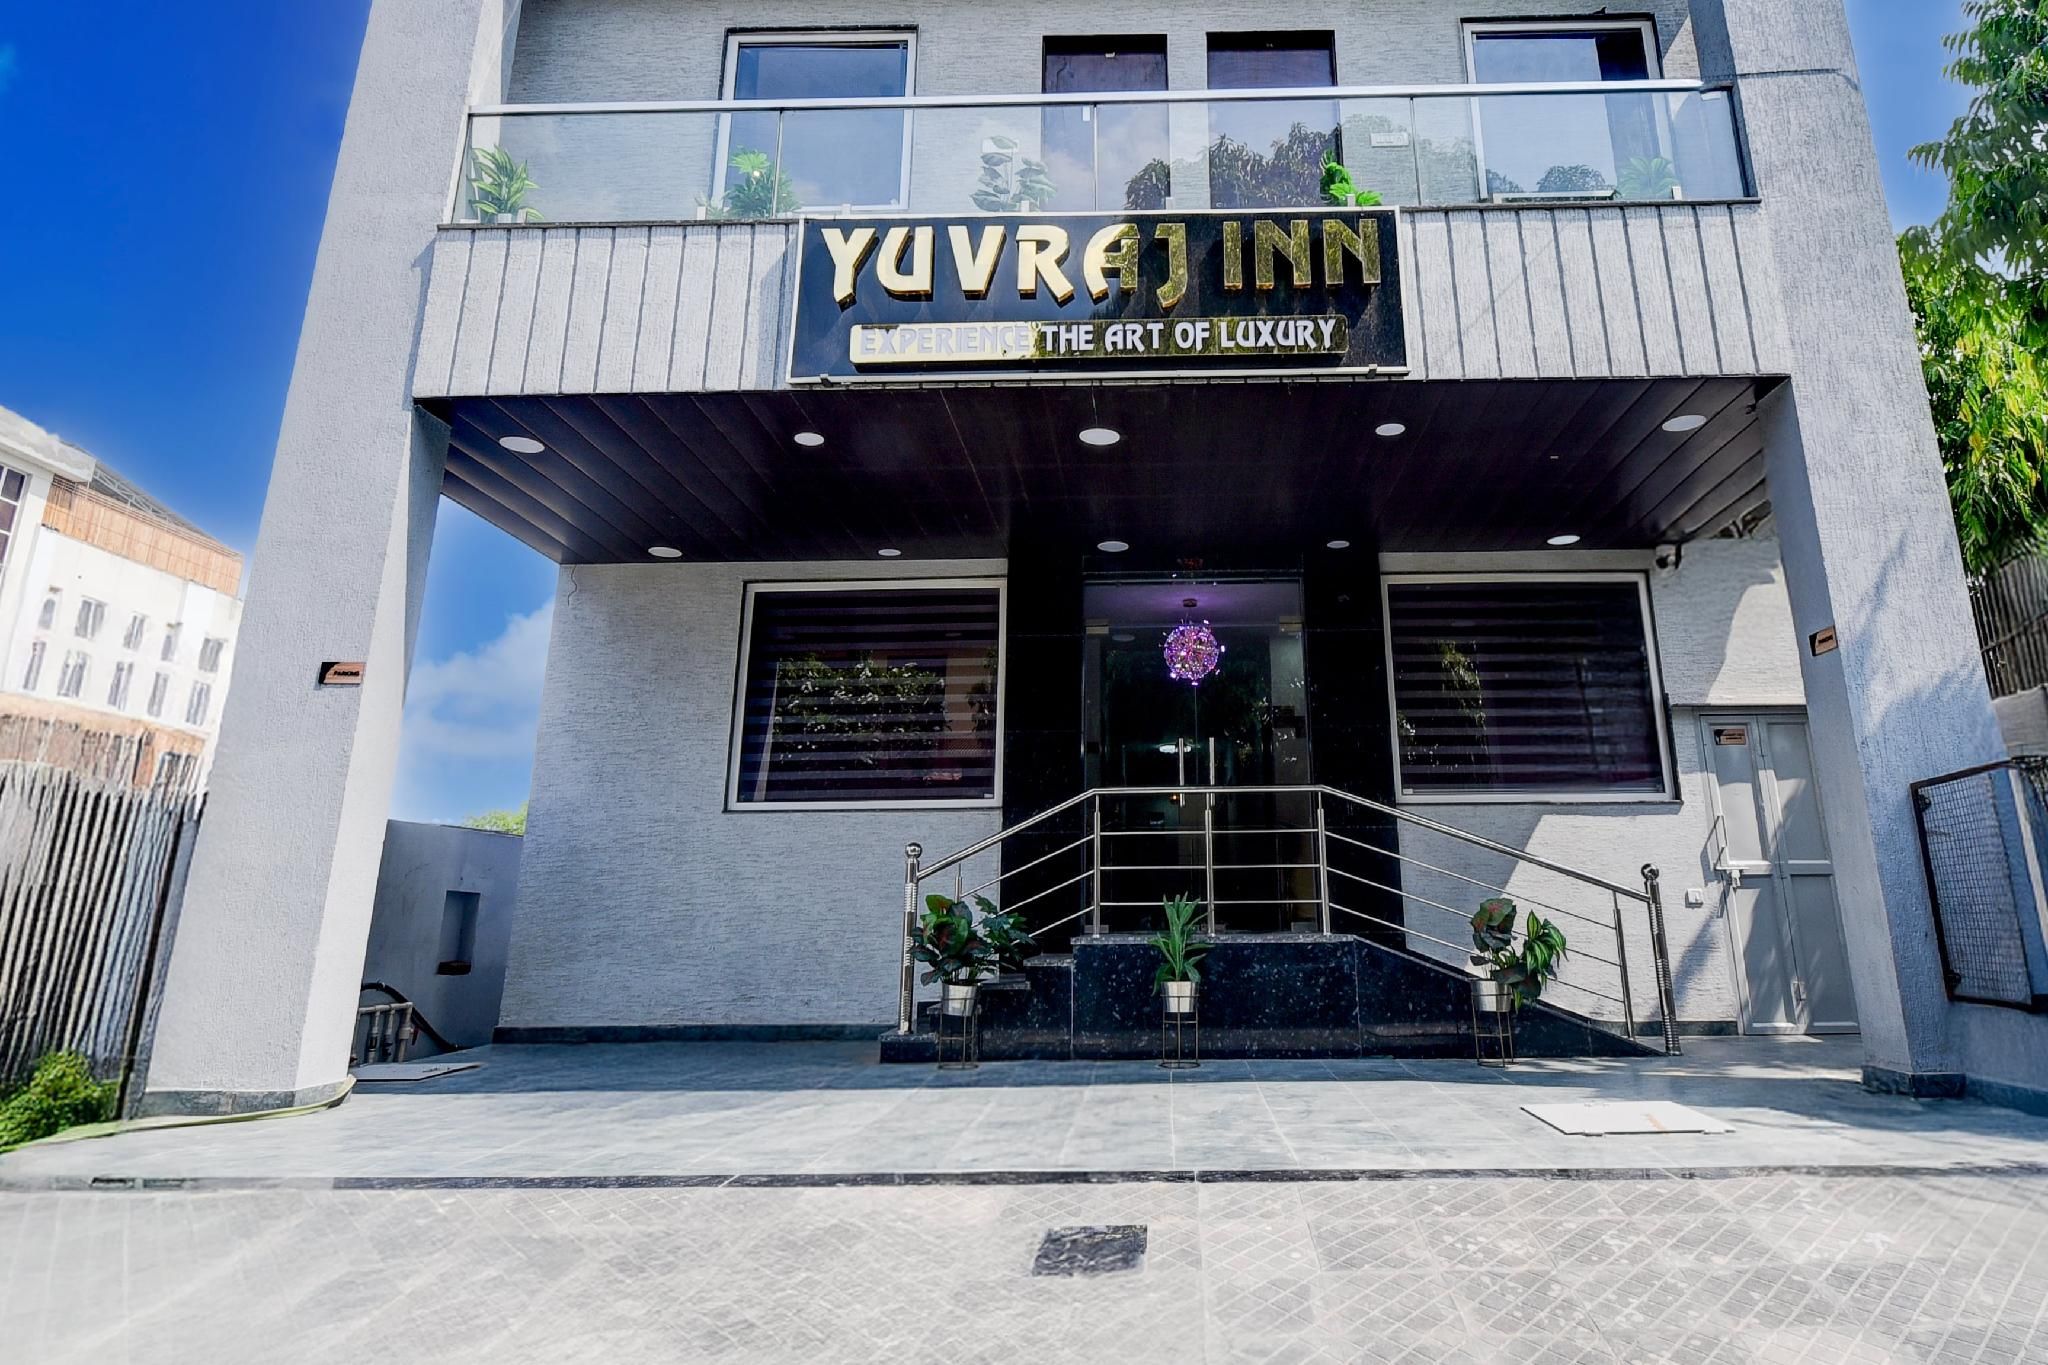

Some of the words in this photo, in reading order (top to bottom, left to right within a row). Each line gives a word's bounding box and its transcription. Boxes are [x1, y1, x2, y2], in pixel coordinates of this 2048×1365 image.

[821, 223, 1188, 309] YUVRAJ
[1223, 219, 1381, 289] INN
[860, 323, 1030, 355] EXPERIENCE
[1041, 324, 1095, 354] THE
[1104, 321, 1164, 352] ART
[1174, 320, 1210, 351] OF
[1220, 317, 1337, 349] LUXURY
